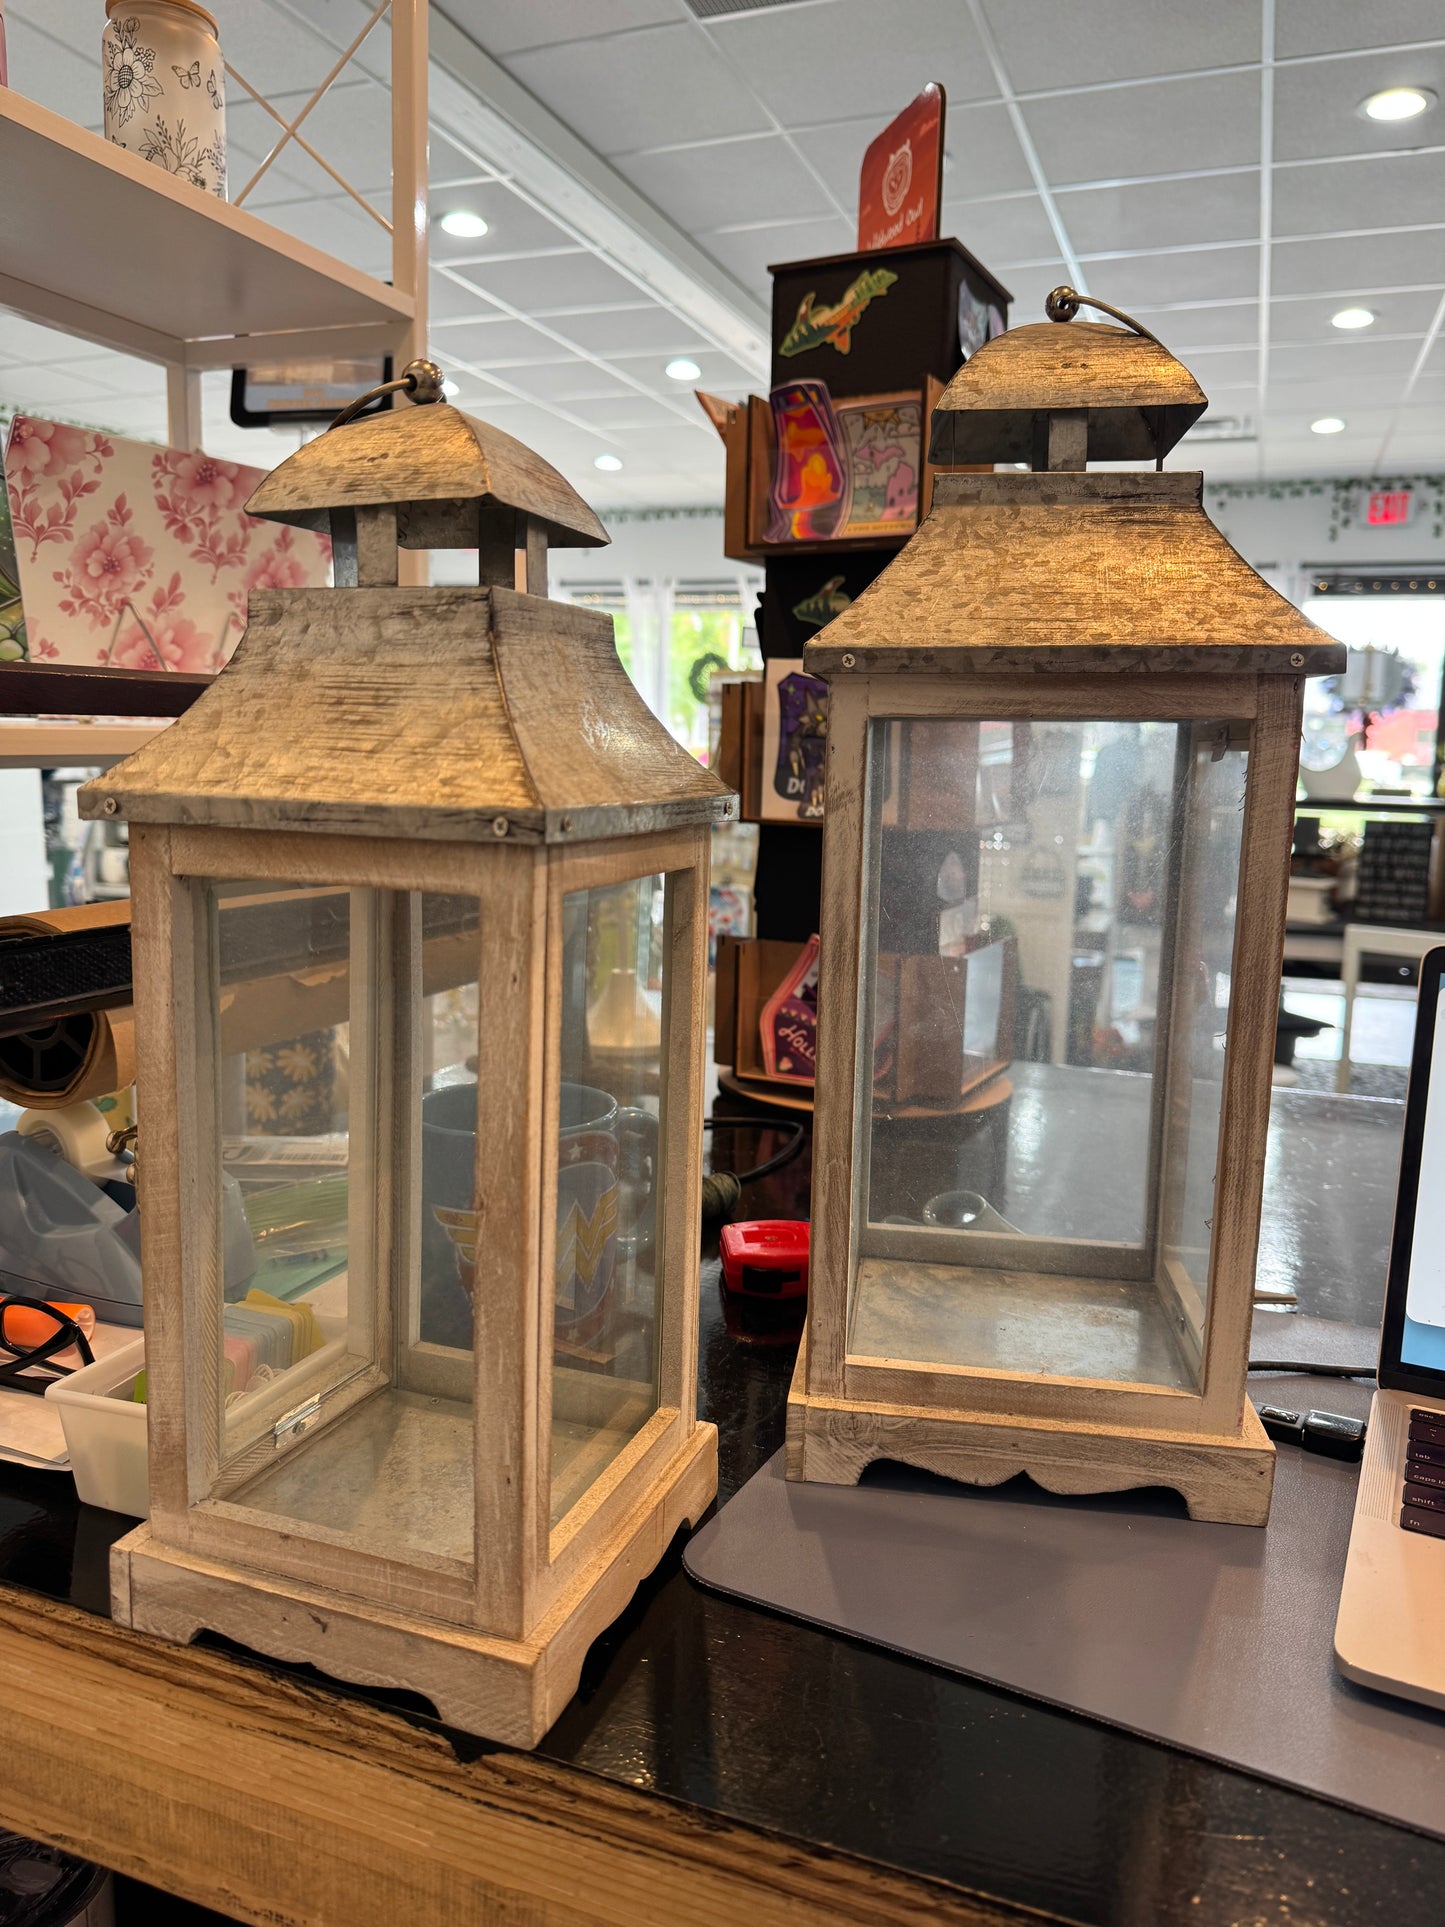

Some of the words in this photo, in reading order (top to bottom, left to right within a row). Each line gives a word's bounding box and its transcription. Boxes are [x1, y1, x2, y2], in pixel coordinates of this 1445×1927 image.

[1415, 1452, 1430, 1460] tab
[1414, 1474, 1436, 1483] caps
[1412, 1497, 1435, 1506] shift
